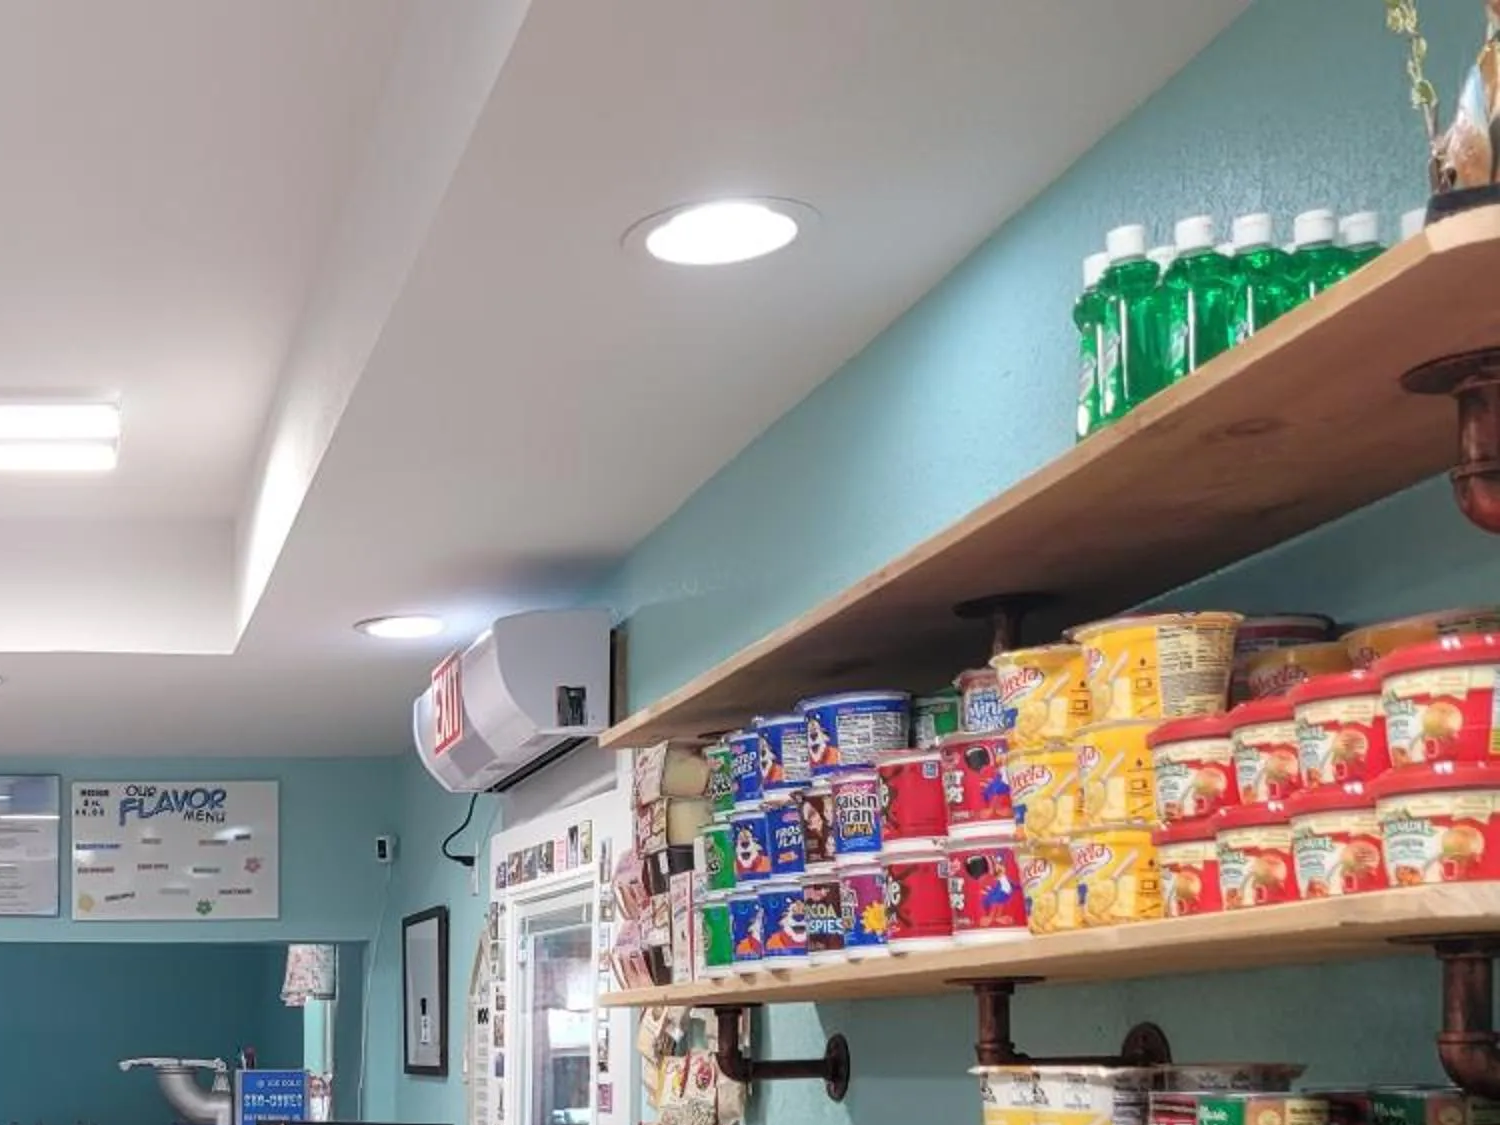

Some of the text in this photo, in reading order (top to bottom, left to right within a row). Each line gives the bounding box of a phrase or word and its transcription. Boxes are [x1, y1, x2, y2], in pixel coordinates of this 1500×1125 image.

[126, 784, 156, 797] OUR
[119, 788, 227, 826] FLAVOR
[183, 810, 227, 823] MENU
